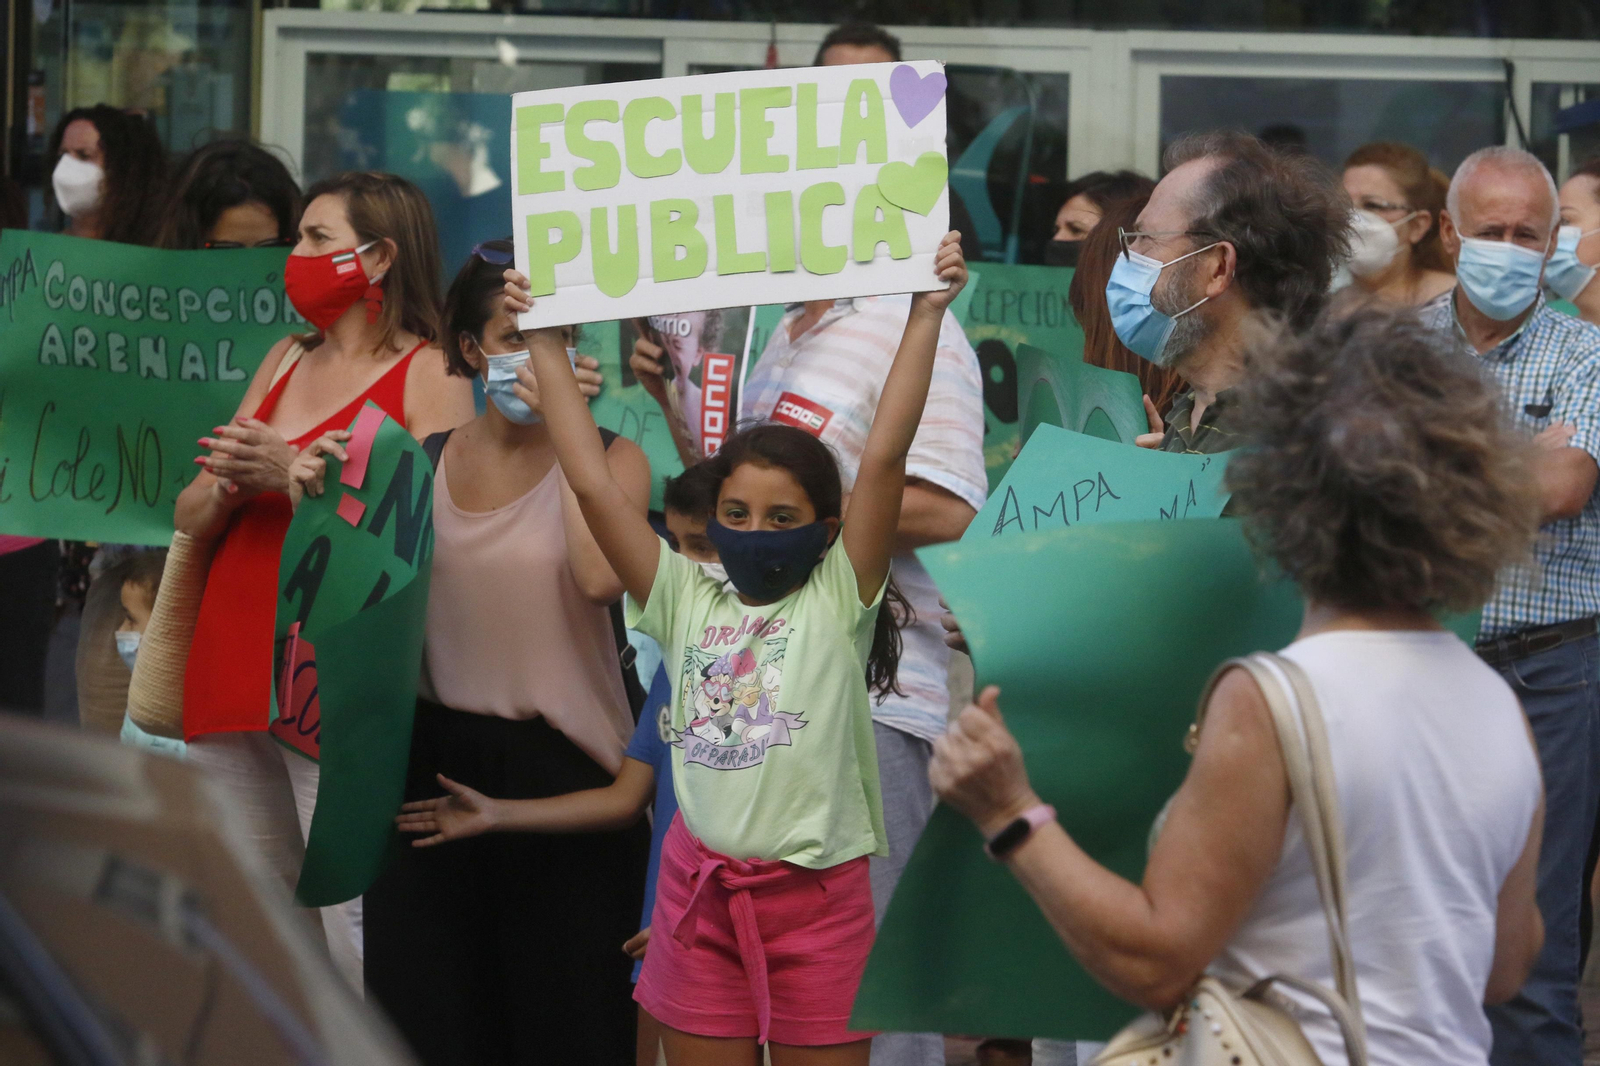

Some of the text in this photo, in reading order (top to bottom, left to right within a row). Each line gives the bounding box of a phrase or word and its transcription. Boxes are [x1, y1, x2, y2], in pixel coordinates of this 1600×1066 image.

[516, 78, 887, 196] ESCUELA
[526, 181, 912, 298] PUBLICA
[39, 323, 248, 382] ARENAL
[992, 471, 1121, 536] AMPA
[708, 738, 770, 768] PARADI
